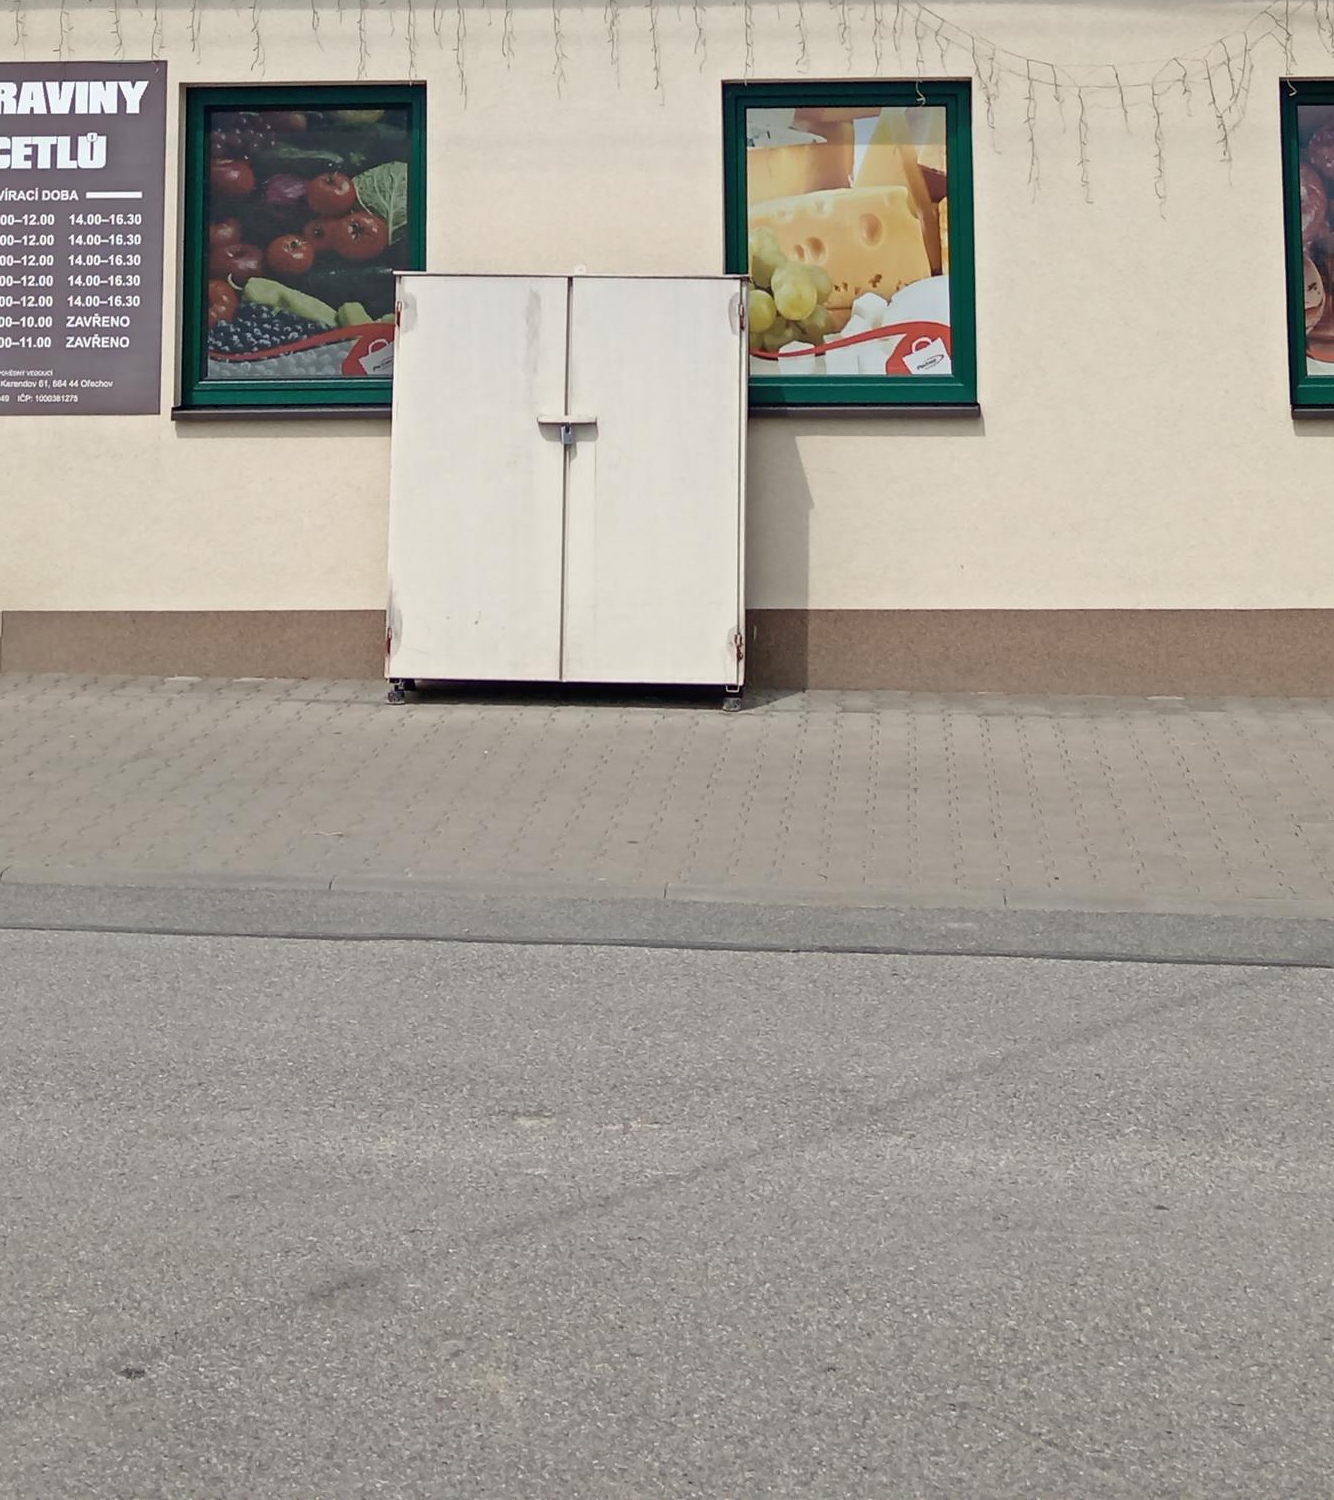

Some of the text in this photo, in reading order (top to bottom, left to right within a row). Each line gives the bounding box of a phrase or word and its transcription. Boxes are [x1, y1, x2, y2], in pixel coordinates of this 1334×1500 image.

[41, 189, 79, 201] DOBA
[65, 313, 131, 328] ZAVŘENO
[65, 334, 130, 349] ZAVŘENO
[0, 379, 38, 388] Kerendov
[68, 379, 79, 388] 44
